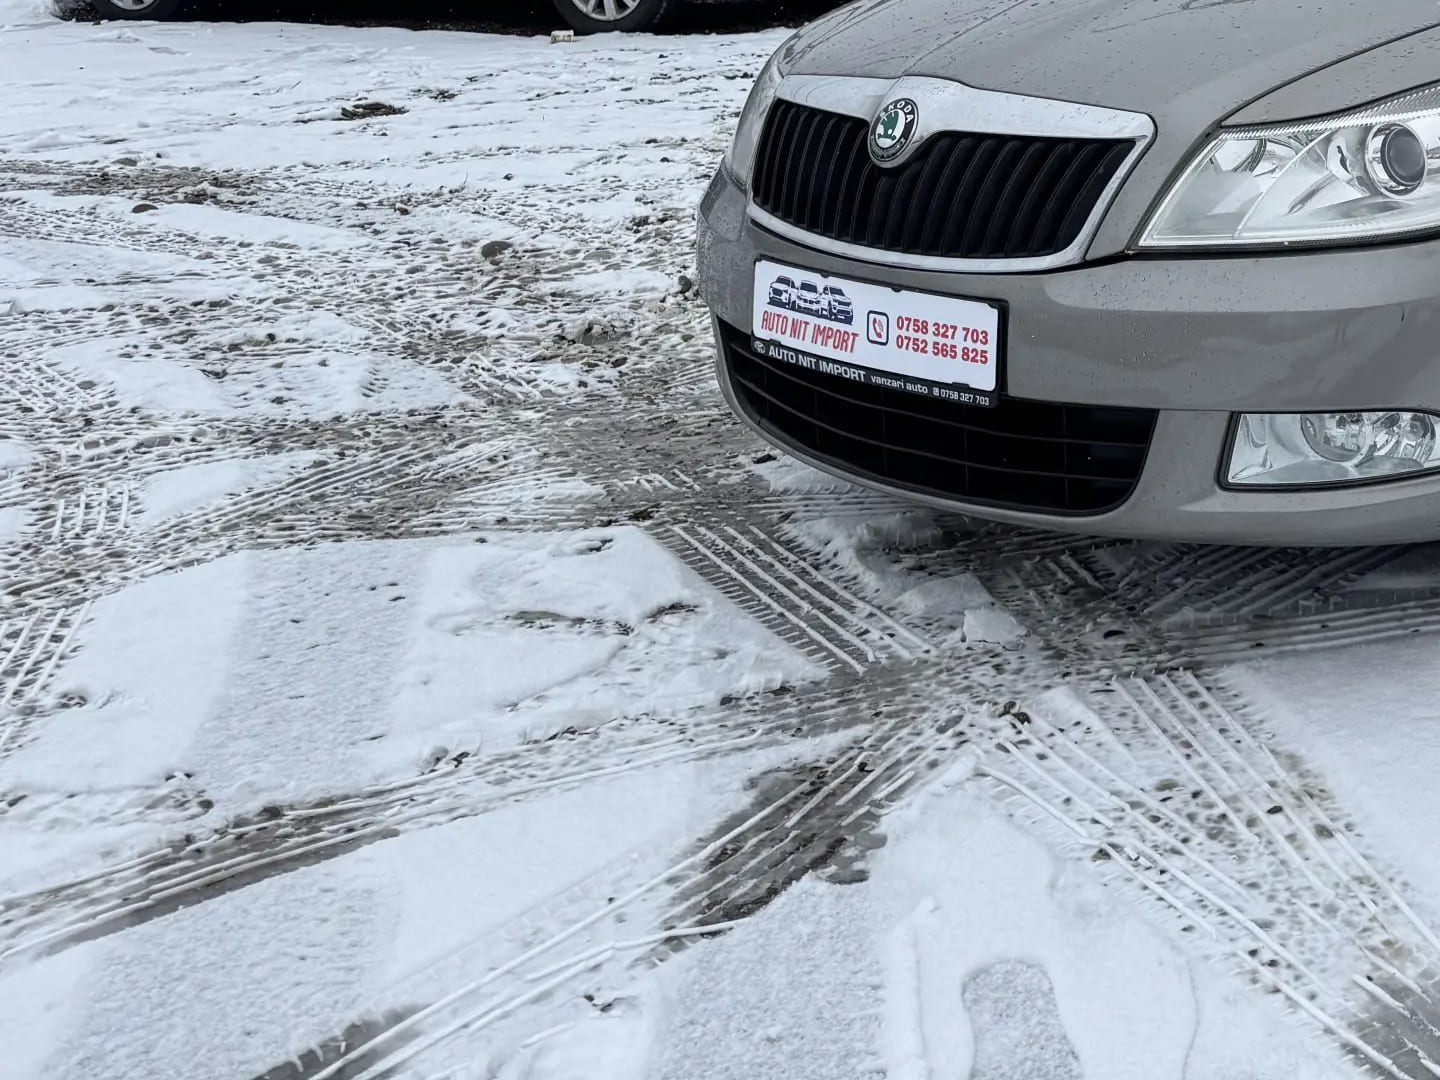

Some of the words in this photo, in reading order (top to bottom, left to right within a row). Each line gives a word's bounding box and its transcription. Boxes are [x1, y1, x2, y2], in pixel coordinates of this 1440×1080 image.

[761, 310, 788, 335] AUTO
[790, 317, 810, 342] NIT
[811, 324, 859, 354] IMPORT
[896, 315, 929, 335] 0758
[932, 322, 958, 340] 327
[962, 326, 989, 346] 703
[896, 334, 928, 354] 0752
[932, 341, 957, 359] 565
[961, 346, 988, 365] 825
[769, 346, 796, 363] AUTO
[798, 354, 817, 369] NIT
[819, 360, 866, 382] IMPORT
[870, 374, 904, 389] vanzari
[906, 382, 928, 394] auto
[941, 388, 958, 400] 0758
[959, 393, 974, 402] 327
[975, 396, 990, 406] 703
